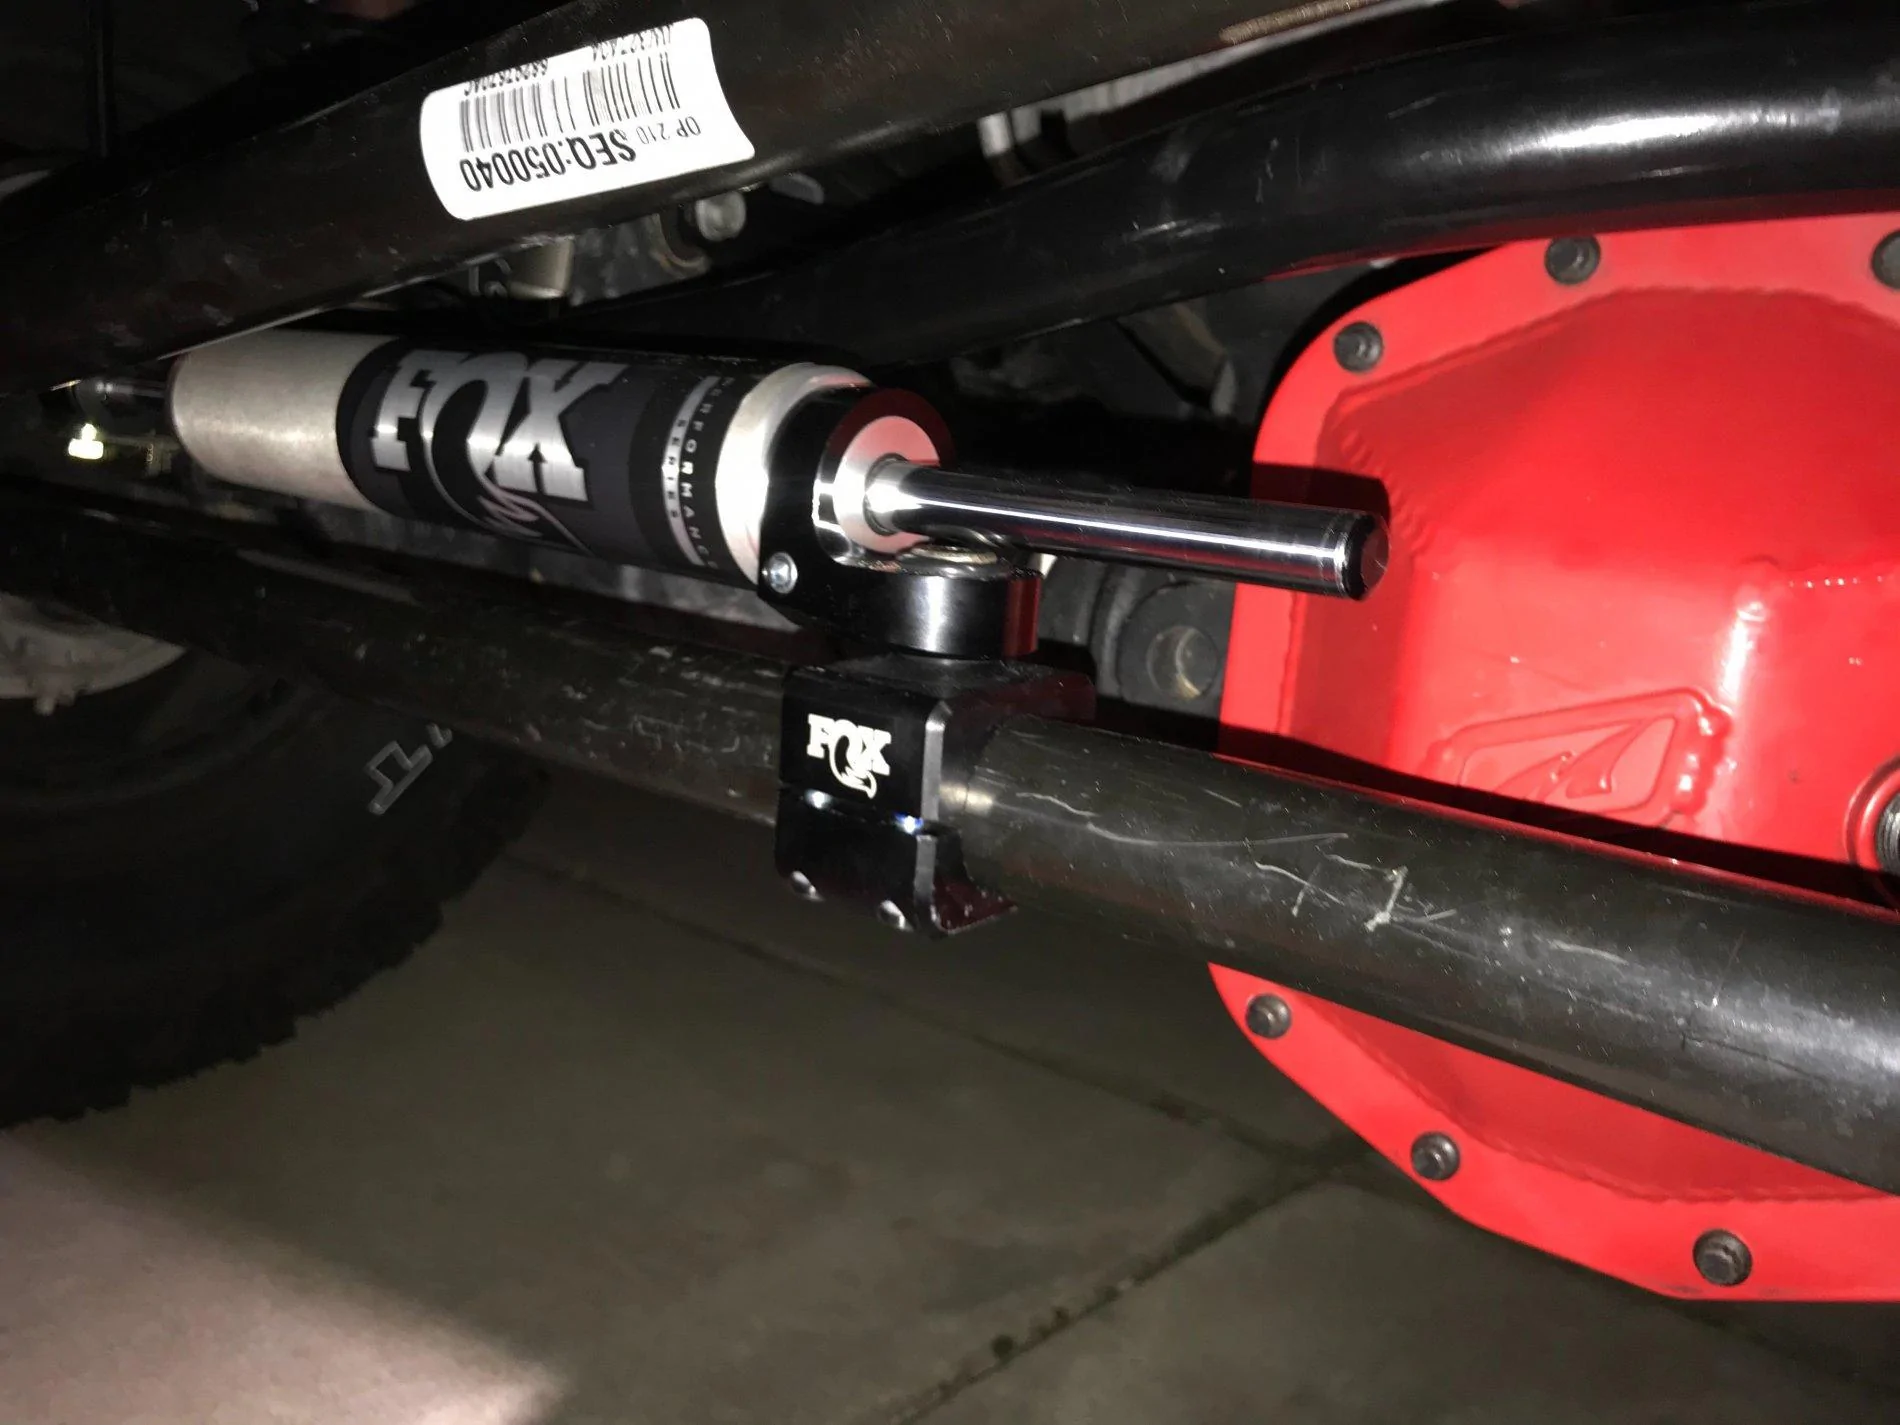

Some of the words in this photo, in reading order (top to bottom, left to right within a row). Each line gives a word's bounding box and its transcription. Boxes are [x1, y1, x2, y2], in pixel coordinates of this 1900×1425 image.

[458, 129, 638, 193] SEQ:050040
[635, 122, 667, 146] 210
[370, 348, 630, 553] FOX
[680, 375, 736, 570] PERFORMANCE
[806, 712, 892, 800] FOX
